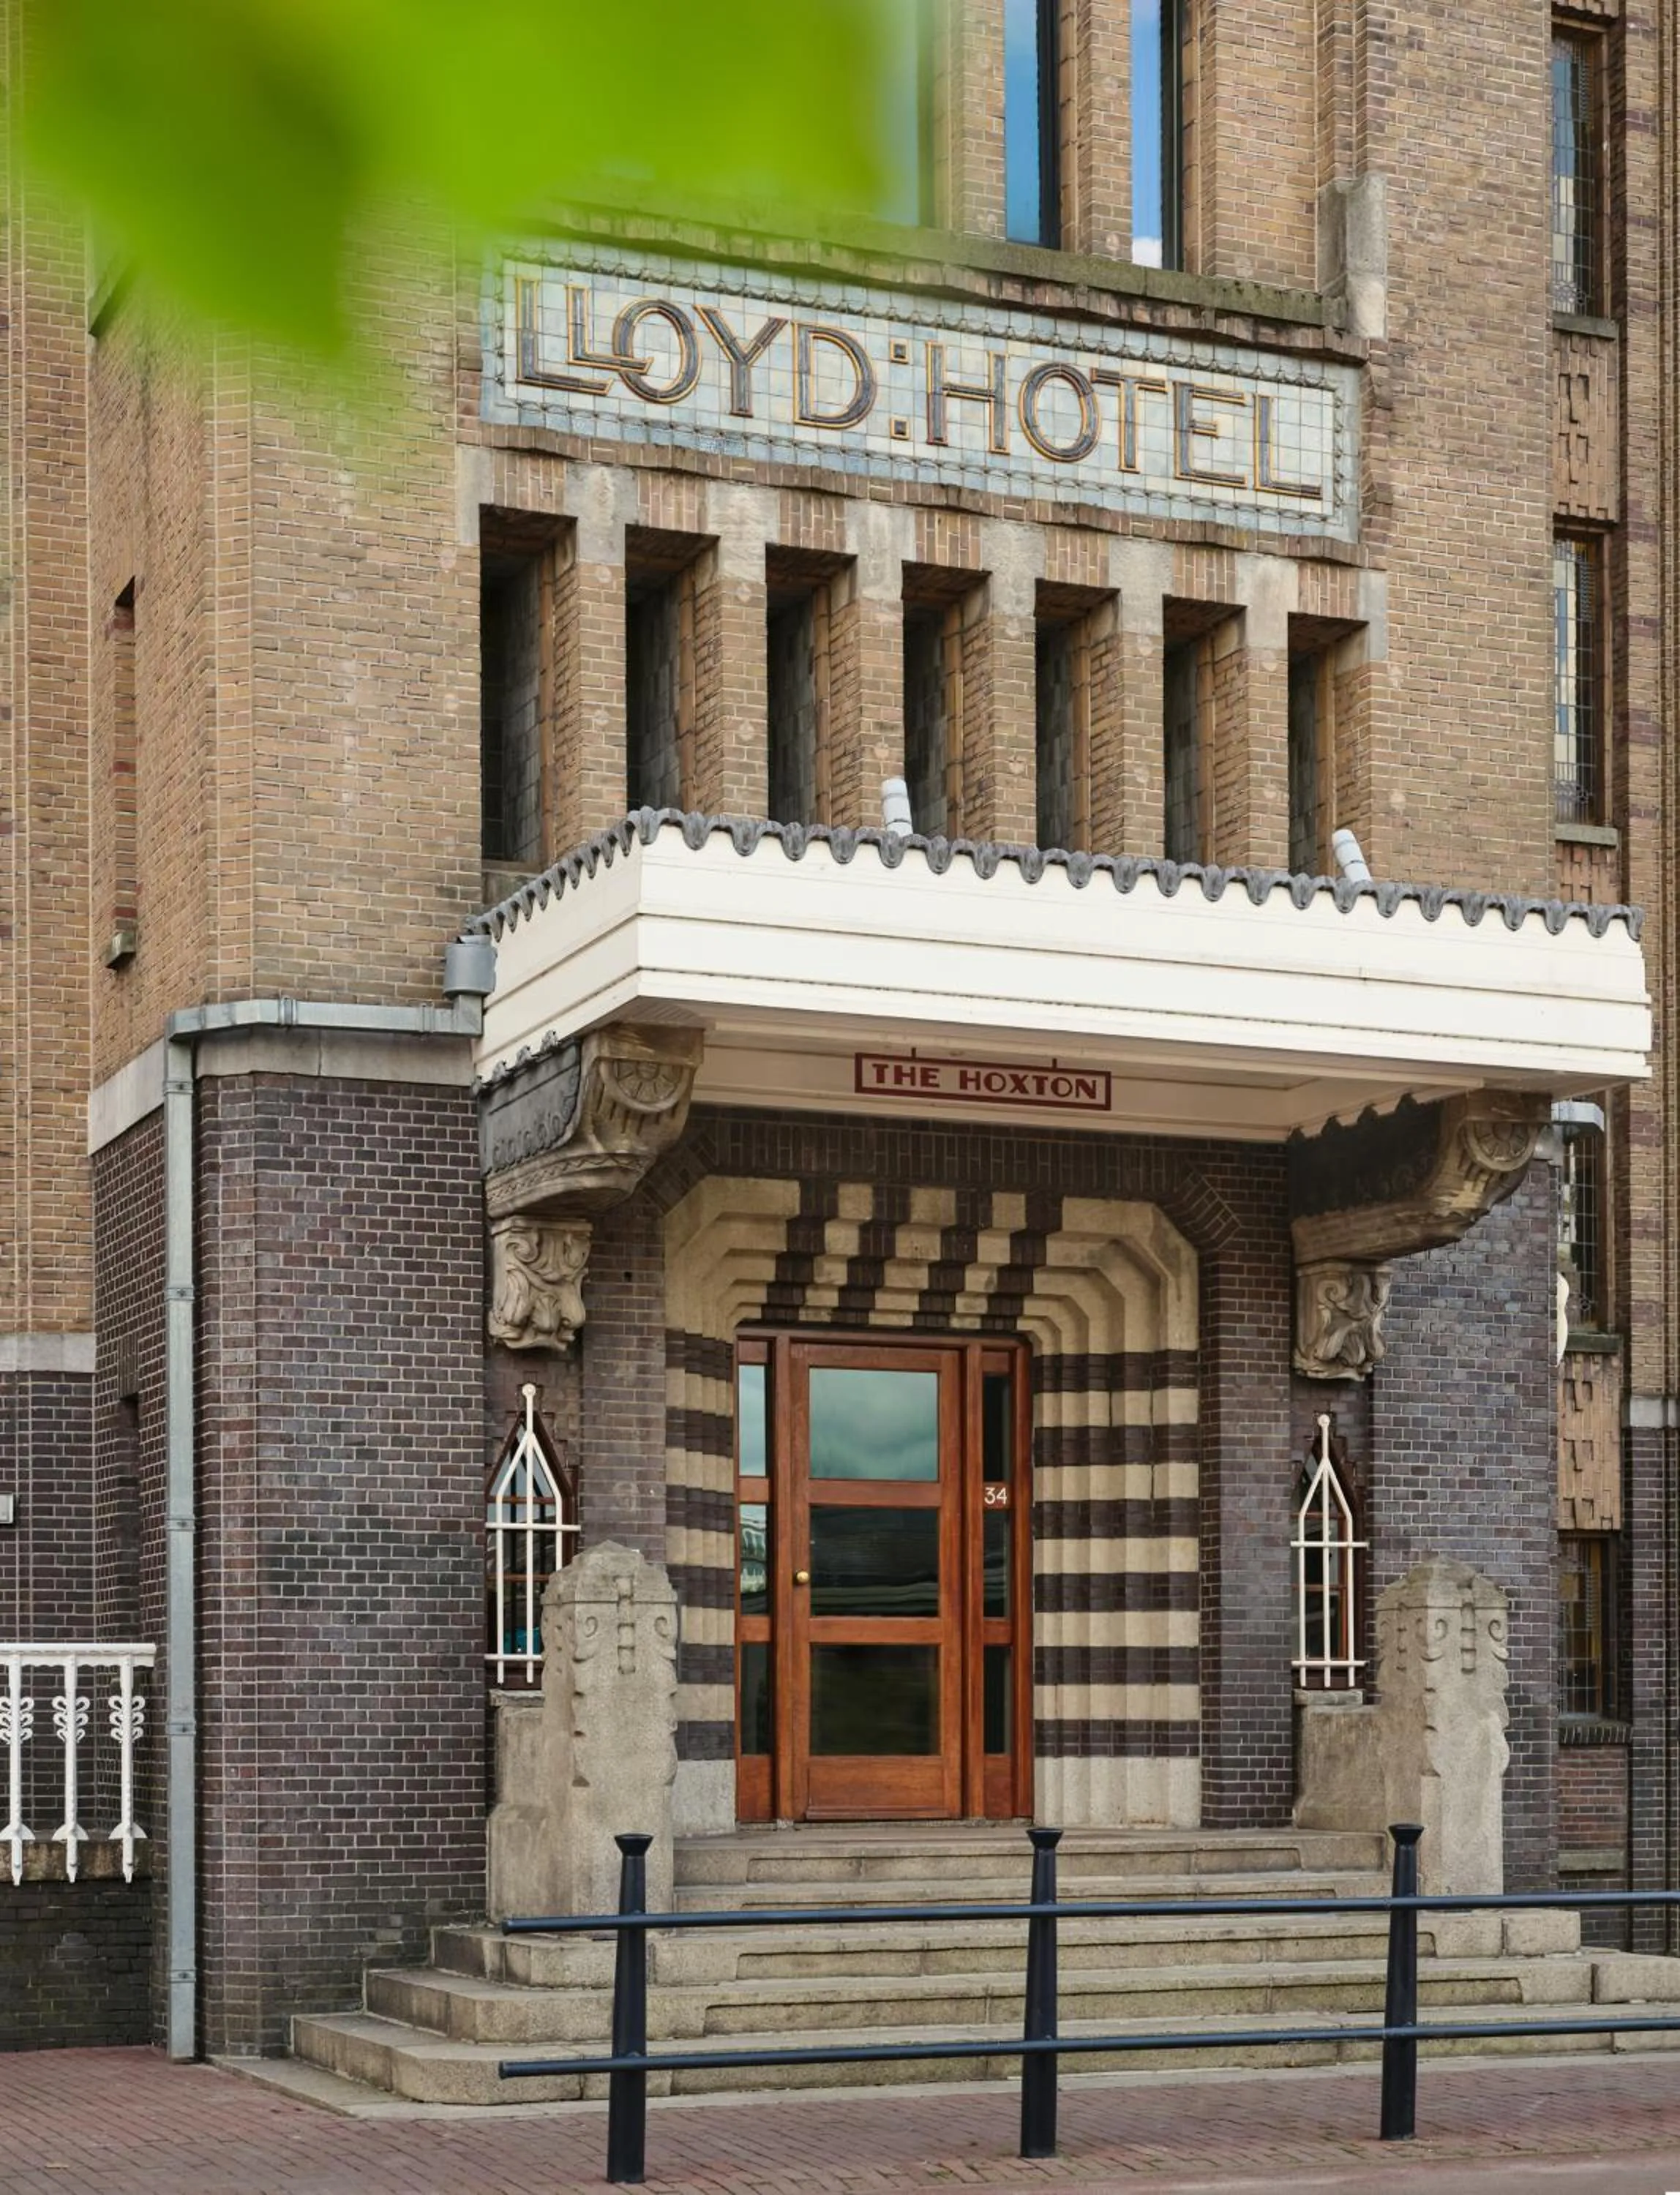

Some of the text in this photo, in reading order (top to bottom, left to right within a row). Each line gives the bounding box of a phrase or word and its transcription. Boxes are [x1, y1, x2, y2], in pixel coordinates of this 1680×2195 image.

[515, 277, 878, 429] LLOYD
[925, 340, 1323, 500] HOTEL
[871, 1063, 1097, 1100] THE HOXTON
[984, 1487, 1008, 1505] 34
